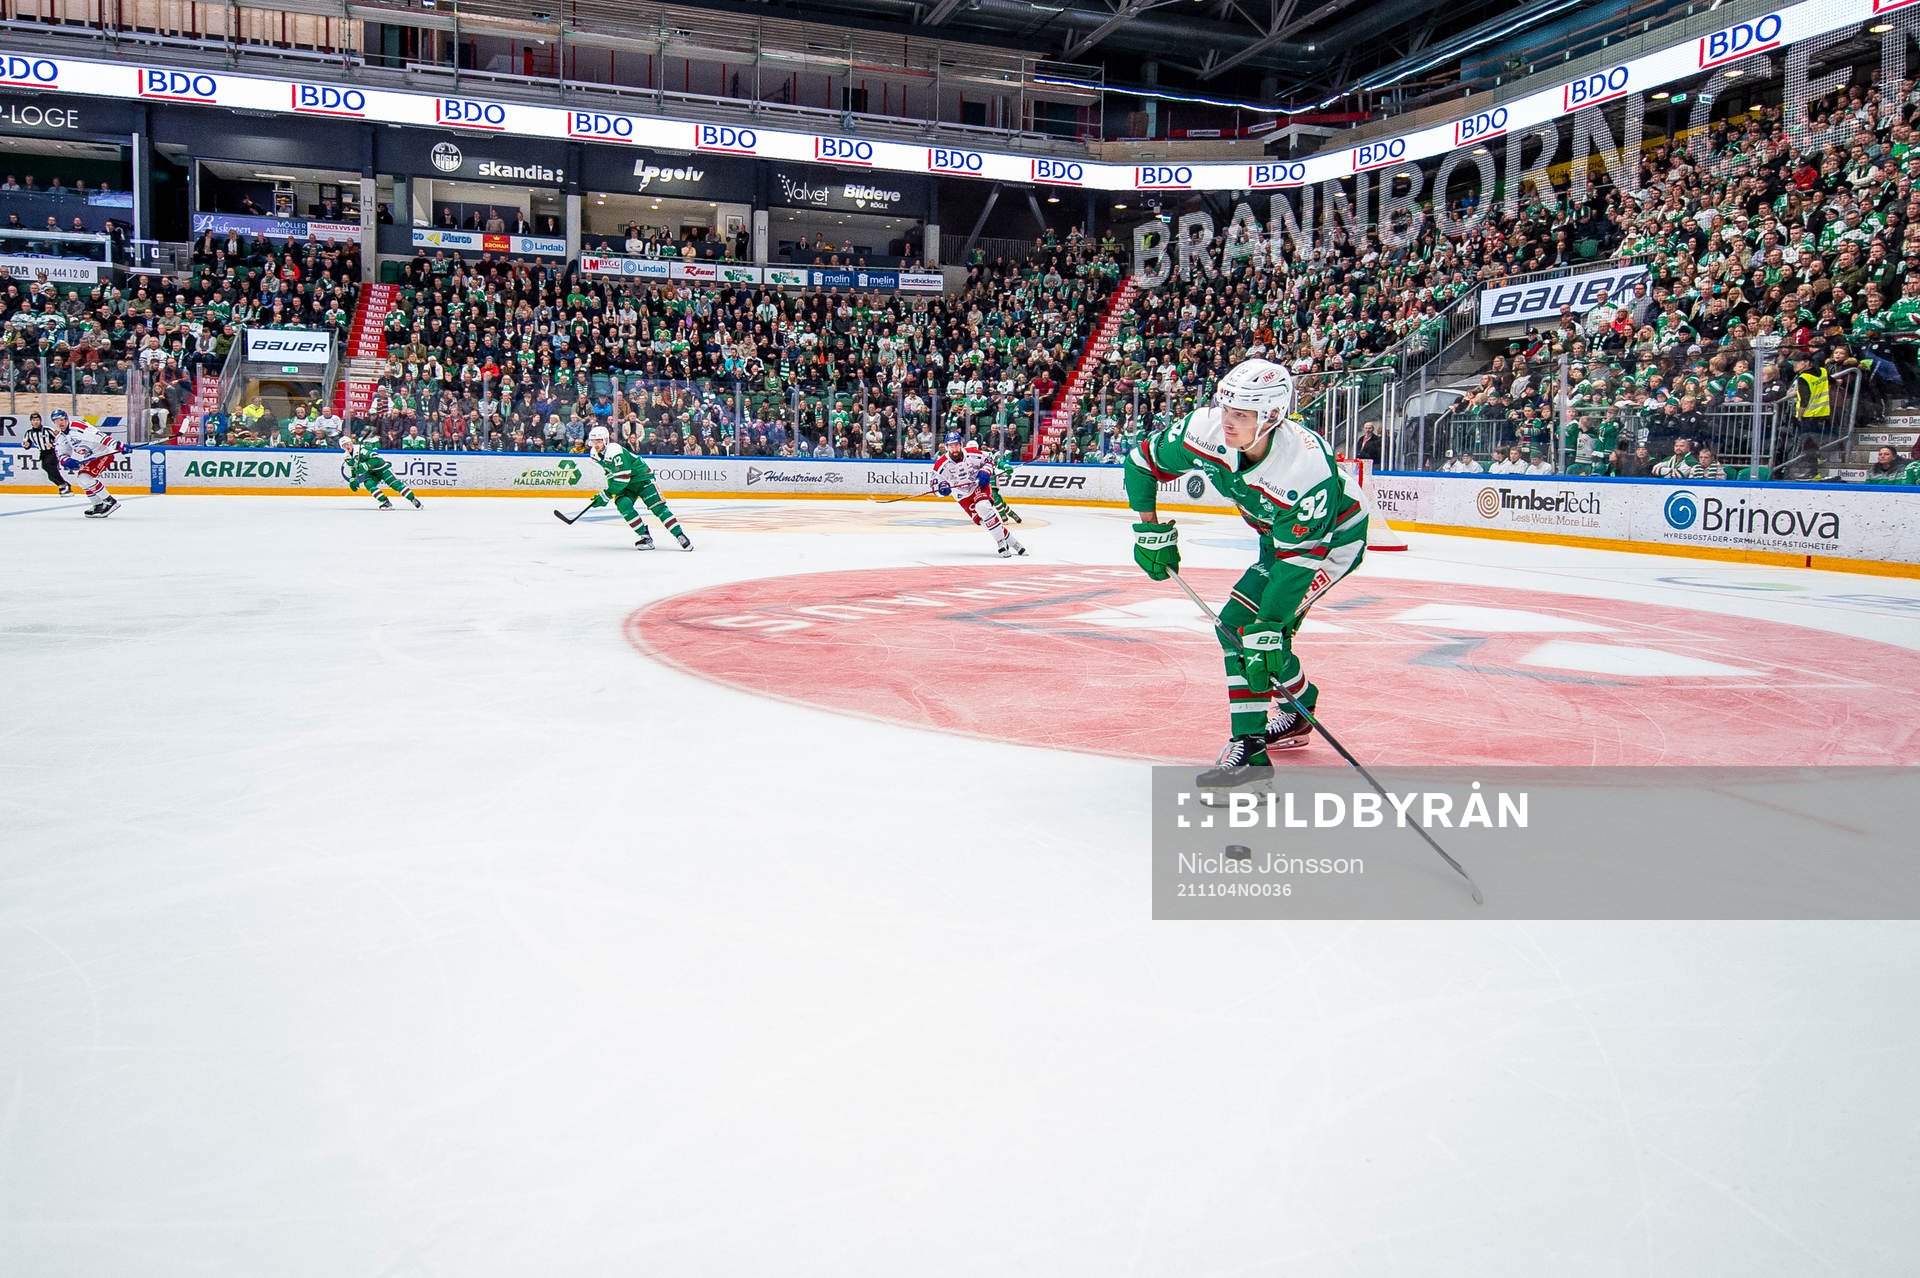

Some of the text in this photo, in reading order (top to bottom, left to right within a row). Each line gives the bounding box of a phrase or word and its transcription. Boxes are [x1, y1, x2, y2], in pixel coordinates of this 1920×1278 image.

[1709, 14, 1783, 59] BDO
[149, 70, 217, 97] BDO
[1571, 66, 1629, 103] BDO
[301, 85, 366, 111] BDO
[445, 99, 506, 124] BDO
[575, 113, 633, 136] BDO
[1462, 107, 1508, 139] BDO
[703, 125, 757, 148] BDO
[822, 138, 873, 160] BDO
[1359, 138, 1406, 166] BDO
[935, 149, 983, 171] BDO
[1038, 160, 1084, 181] BDO
[1142, 167, 1193, 185] BDO
[1255, 163, 1306, 183] BDO
[785, 181, 830, 202] Valvet
[843, 183, 901, 202] Bildeve
[535, 243, 564, 252] Lindab
[583, 259, 599, 271] LM
[637, 264, 666, 274] Lindab
[825, 274, 850, 283] melin
[870, 276, 895, 285] melin
[252, 340, 327, 353] BAUER
[184, 460, 292, 478] AGRIZON
[867, 470, 929, 485] Backahil
[1297, 488, 1328, 522] 92
[1377, 488, 1419, 501] SVENSKA
[1499, 487, 1600, 515] TimberTech
[1377, 500, 1399, 512] SPEL
[1703, 498, 1840, 540] Brinova
